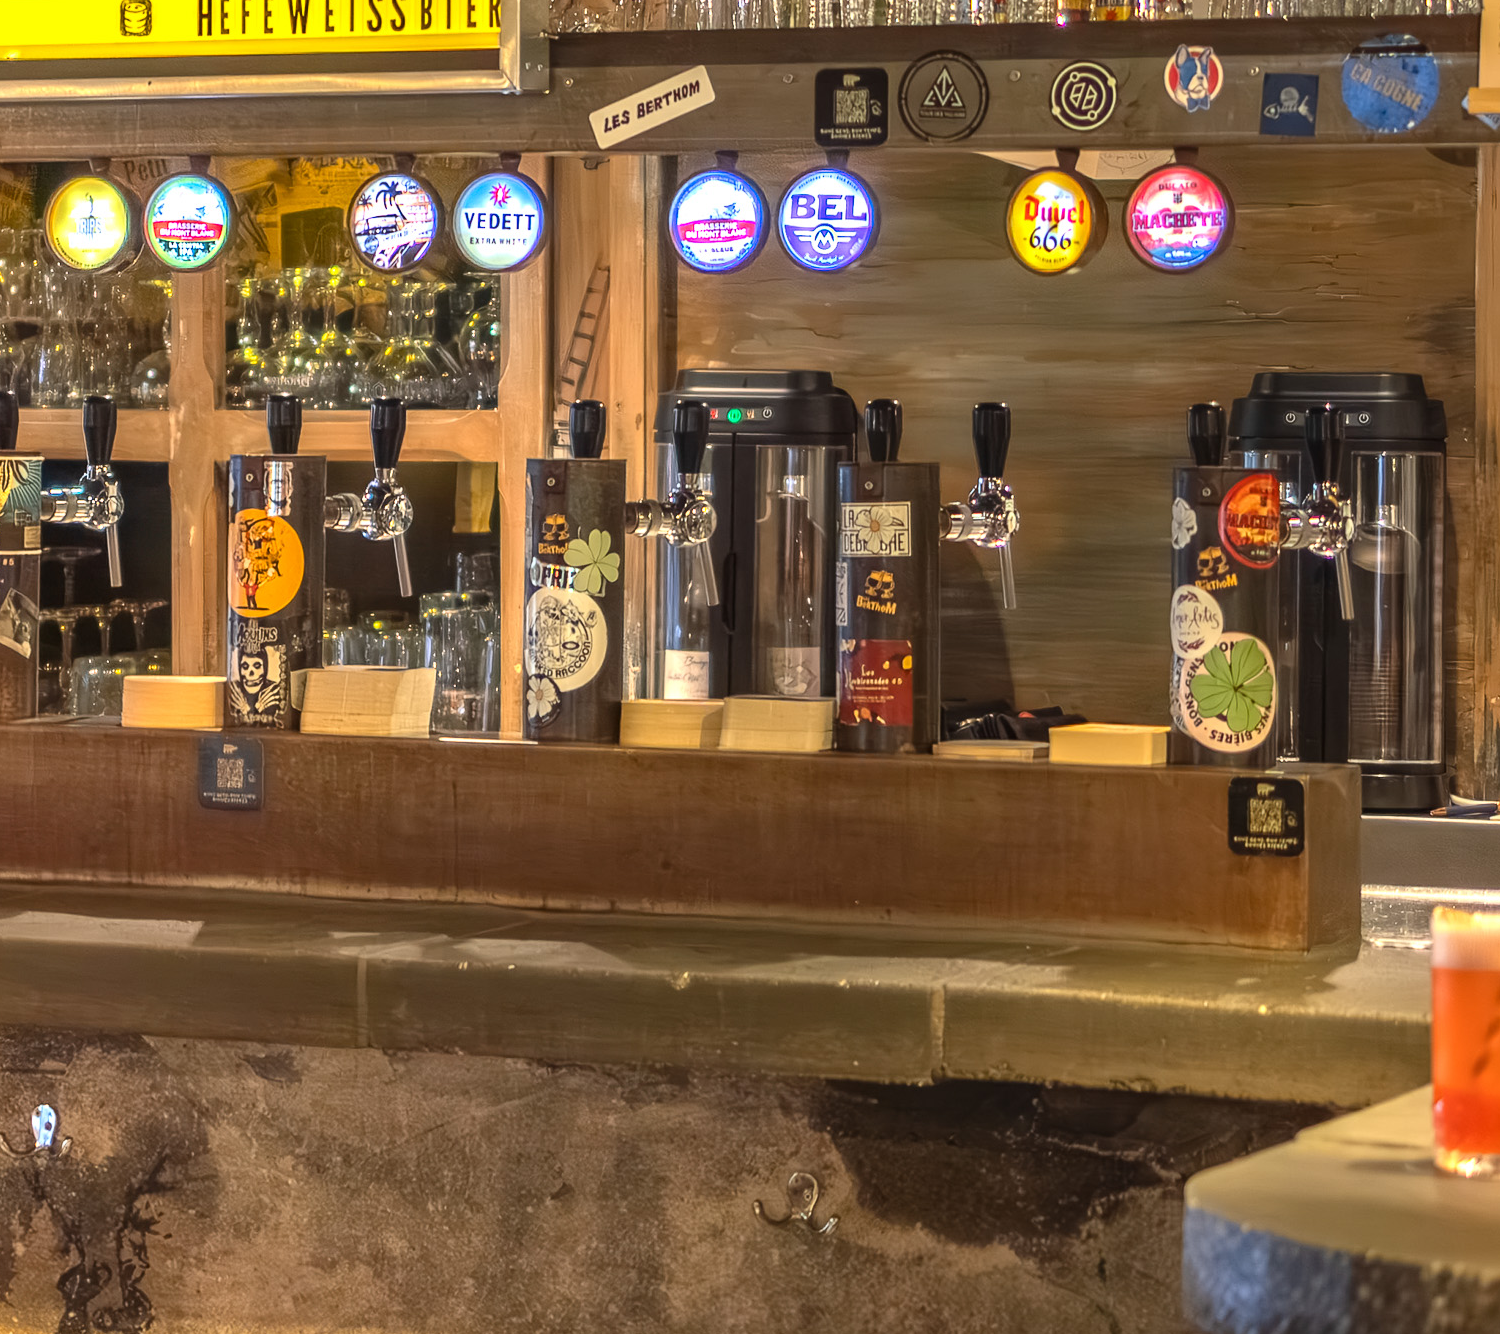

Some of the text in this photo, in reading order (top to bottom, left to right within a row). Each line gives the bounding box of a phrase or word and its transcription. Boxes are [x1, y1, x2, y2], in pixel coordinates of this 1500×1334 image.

[603, 78, 701, 134] LES BERTHOM
[1158, 181, 1198, 191] DUCATO
[790, 193, 868, 221] BEL
[1024, 194, 1085, 225] Duvel
[463, 211, 536, 230] VEDETT
[1132, 210, 1225, 232] MACHETE
[469, 237, 497, 246] EXTRA
[842, 508, 855, 529] LA
[1184, 692, 1204, 728] BONS
